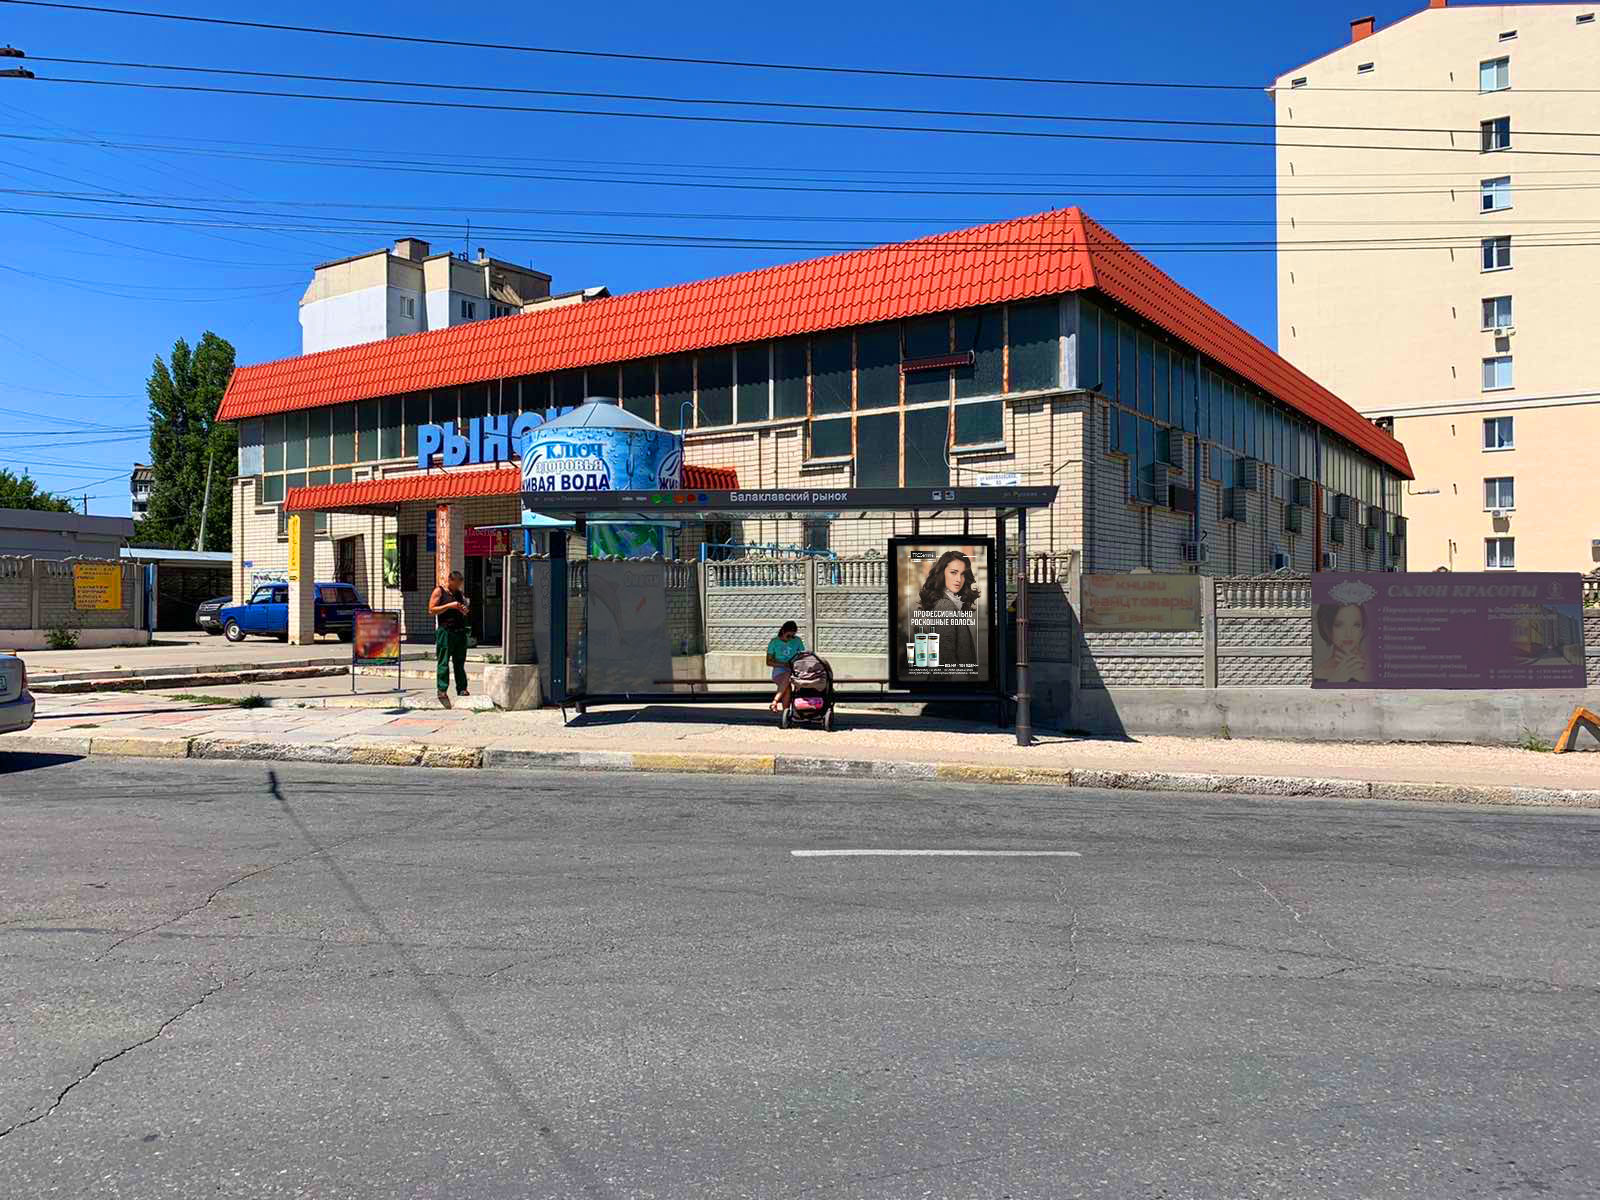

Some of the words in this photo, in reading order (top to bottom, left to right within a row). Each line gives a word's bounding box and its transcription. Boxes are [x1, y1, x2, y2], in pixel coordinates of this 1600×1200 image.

[417, 406, 576, 469] РЫНО
[546, 443, 605, 459] КЛЮЧ
[536, 460, 604, 474] здоровья
[561, 474, 611, 492] ВОДА
[730, 491, 810, 502] Балаклавский
[812, 492, 848, 503] рынок
[1387, 584, 1449, 598] САЛОН
[1452, 584, 1538, 598] КРАСОТЫ
[913, 610, 973, 618] ПРОФЕССИОНАЛЬНО
[910, 618, 950, 626] РОСКОШНЫЕ
[950, 618, 976, 626] ВОЛОСЫ
